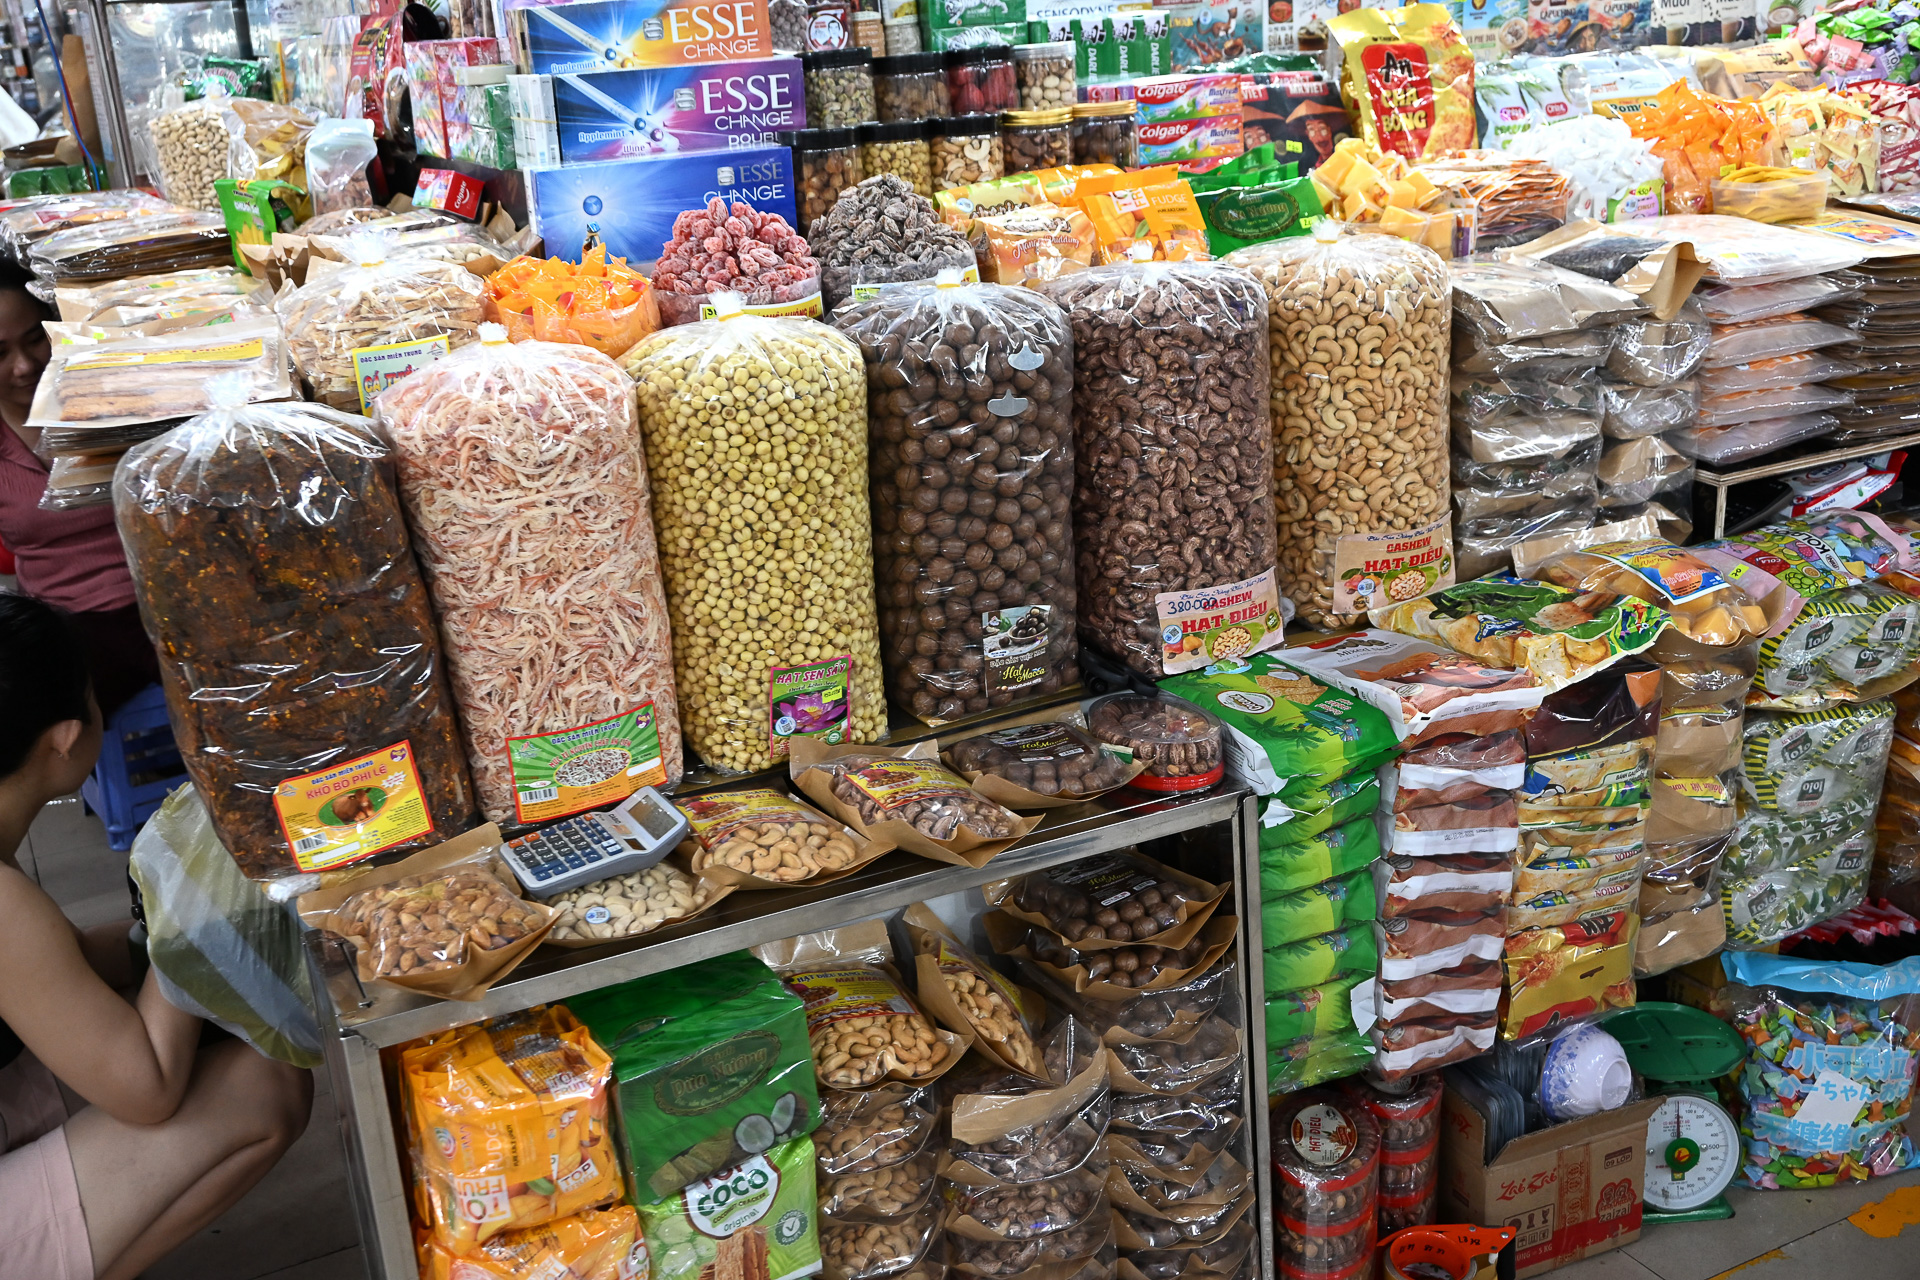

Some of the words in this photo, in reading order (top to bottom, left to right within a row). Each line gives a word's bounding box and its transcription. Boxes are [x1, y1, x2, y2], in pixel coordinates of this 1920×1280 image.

[667, 2, 758, 43] ESSE
[683, 38, 760, 59] CHANGE
[1151, 42, 1160, 75] DARLIE
[551, 61, 597, 74] Applemint
[1087, 48, 1098, 82] DARLIE
[1119, 45, 1129, 80] DARLIE
[1379, 51, 1414, 83] An
[700, 74, 792, 114] ESSE
[1138, 83, 1186, 100] Colgate
[715, 111, 793, 132] CHANGE
[1139, 123, 1188, 140] Colgate
[579, 130, 625, 143] Applemint
[728, 131, 779, 145] DOUBL
[623, 144, 646, 153] Wine
[739, 162, 783, 183] ESSE
[454, 180, 468, 209] Colgate
[703, 184, 785, 206] CHANGE
[1151, 194, 1187, 206] FUDGE
[404, 349, 422, 357] TRUNG
[363, 370, 381, 393] CÁ
[1822, 498, 1836, 508] Wipes
[1386, 536, 1431, 553] CASHEW
[1364, 557, 1405, 573] HẠT
[1408, 545, 1443, 567] ĐIỀU
[1761, 556, 1781, 565] COLA
[1203, 590, 1252, 611] CASHEW
[1181, 614, 1224, 633] HẠT
[1229, 600, 1268, 624] ĐIỀU
[776, 671, 801, 686] HẠT
[802, 668, 825, 682] SEN
[825, 660, 846, 678] SẤY
[1016, 668, 1046, 683] Macca
[600, 721, 620, 733] TRUNG
[306, 783, 331, 799] KHÔ
[333, 778, 350, 791] BÒ
[352, 771, 371, 784] PHI
[373, 763, 387, 777] LÊ
[1594, 884, 1623, 898] ORION
[485, 1122, 503, 1172] FUDGE
[1605, 1159, 1615, 1167] 09
[561, 1162, 591, 1187] TOP
[1496, 1178, 1526, 1201] Zai
[1527, 1167, 1558, 1195] Zai
[697, 1169, 769, 1216] COCO
[724, 1208, 760, 1232] Original
[1600, 1206, 1631, 1222] zaizai
